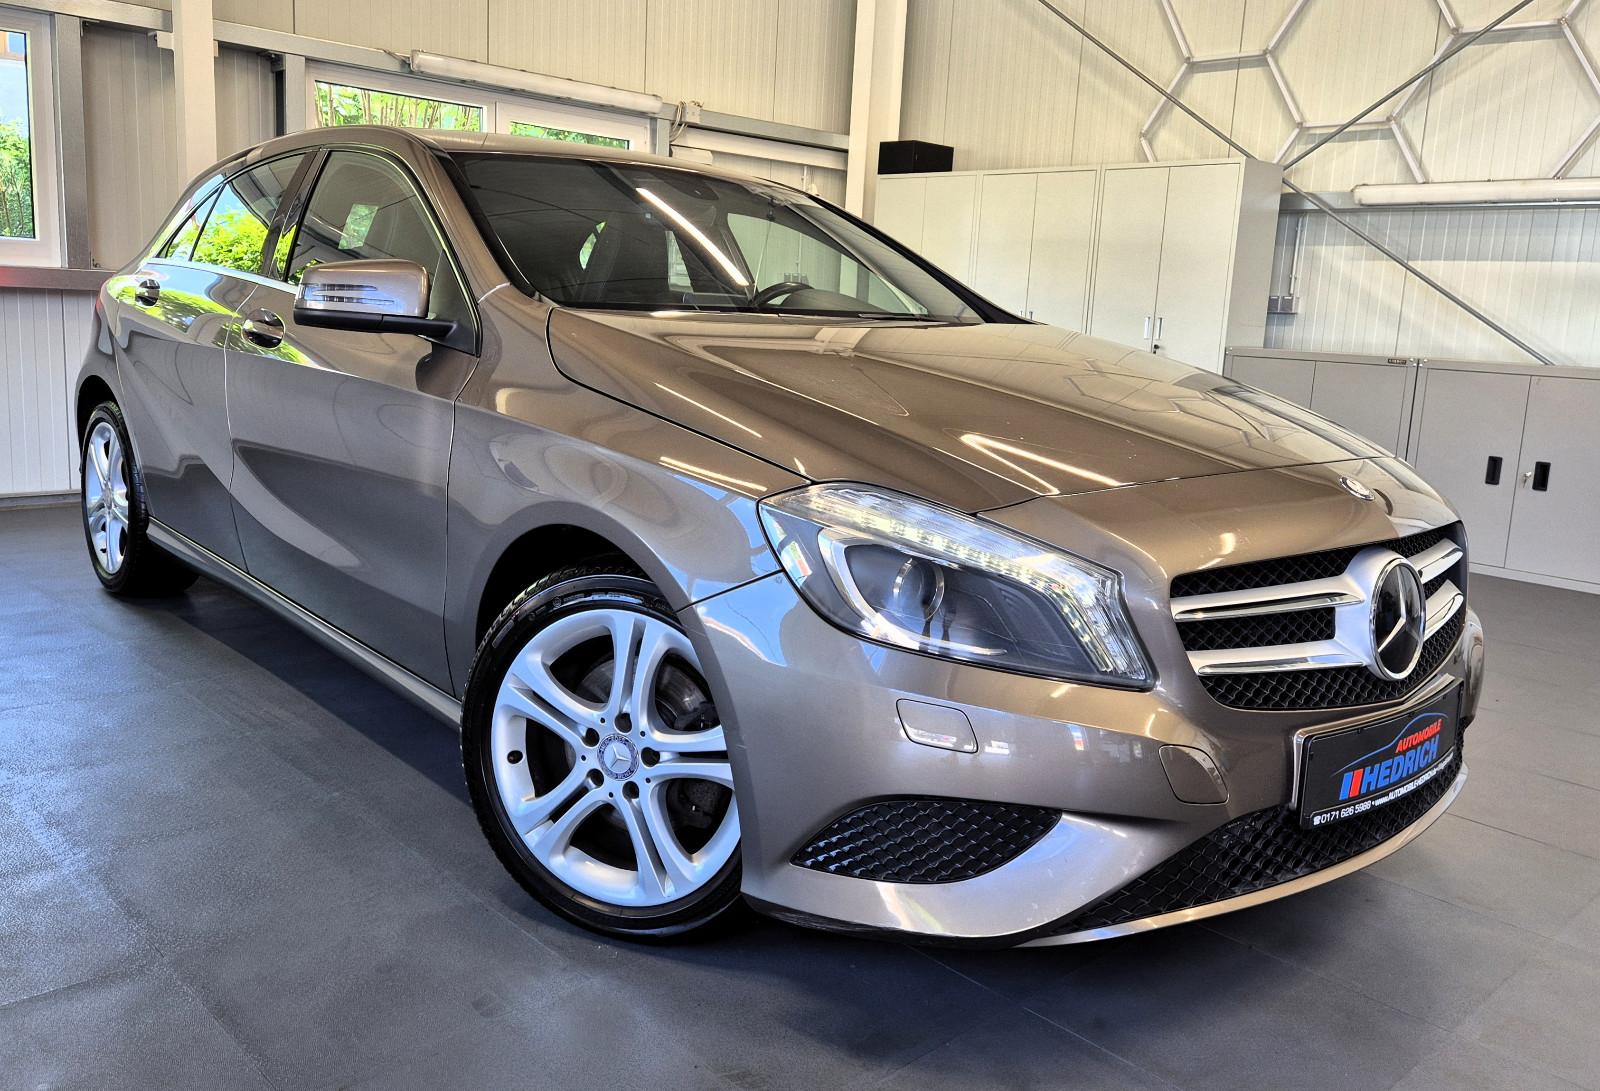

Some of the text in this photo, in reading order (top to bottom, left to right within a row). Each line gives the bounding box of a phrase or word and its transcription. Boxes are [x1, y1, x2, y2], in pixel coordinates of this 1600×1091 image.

[1395, 719, 1443, 753] AUTOMOBILE
[1361, 734, 1440, 794] HEDRICH
[1321, 811, 1340, 824] 0171
[1341, 806, 1355, 818] 626
